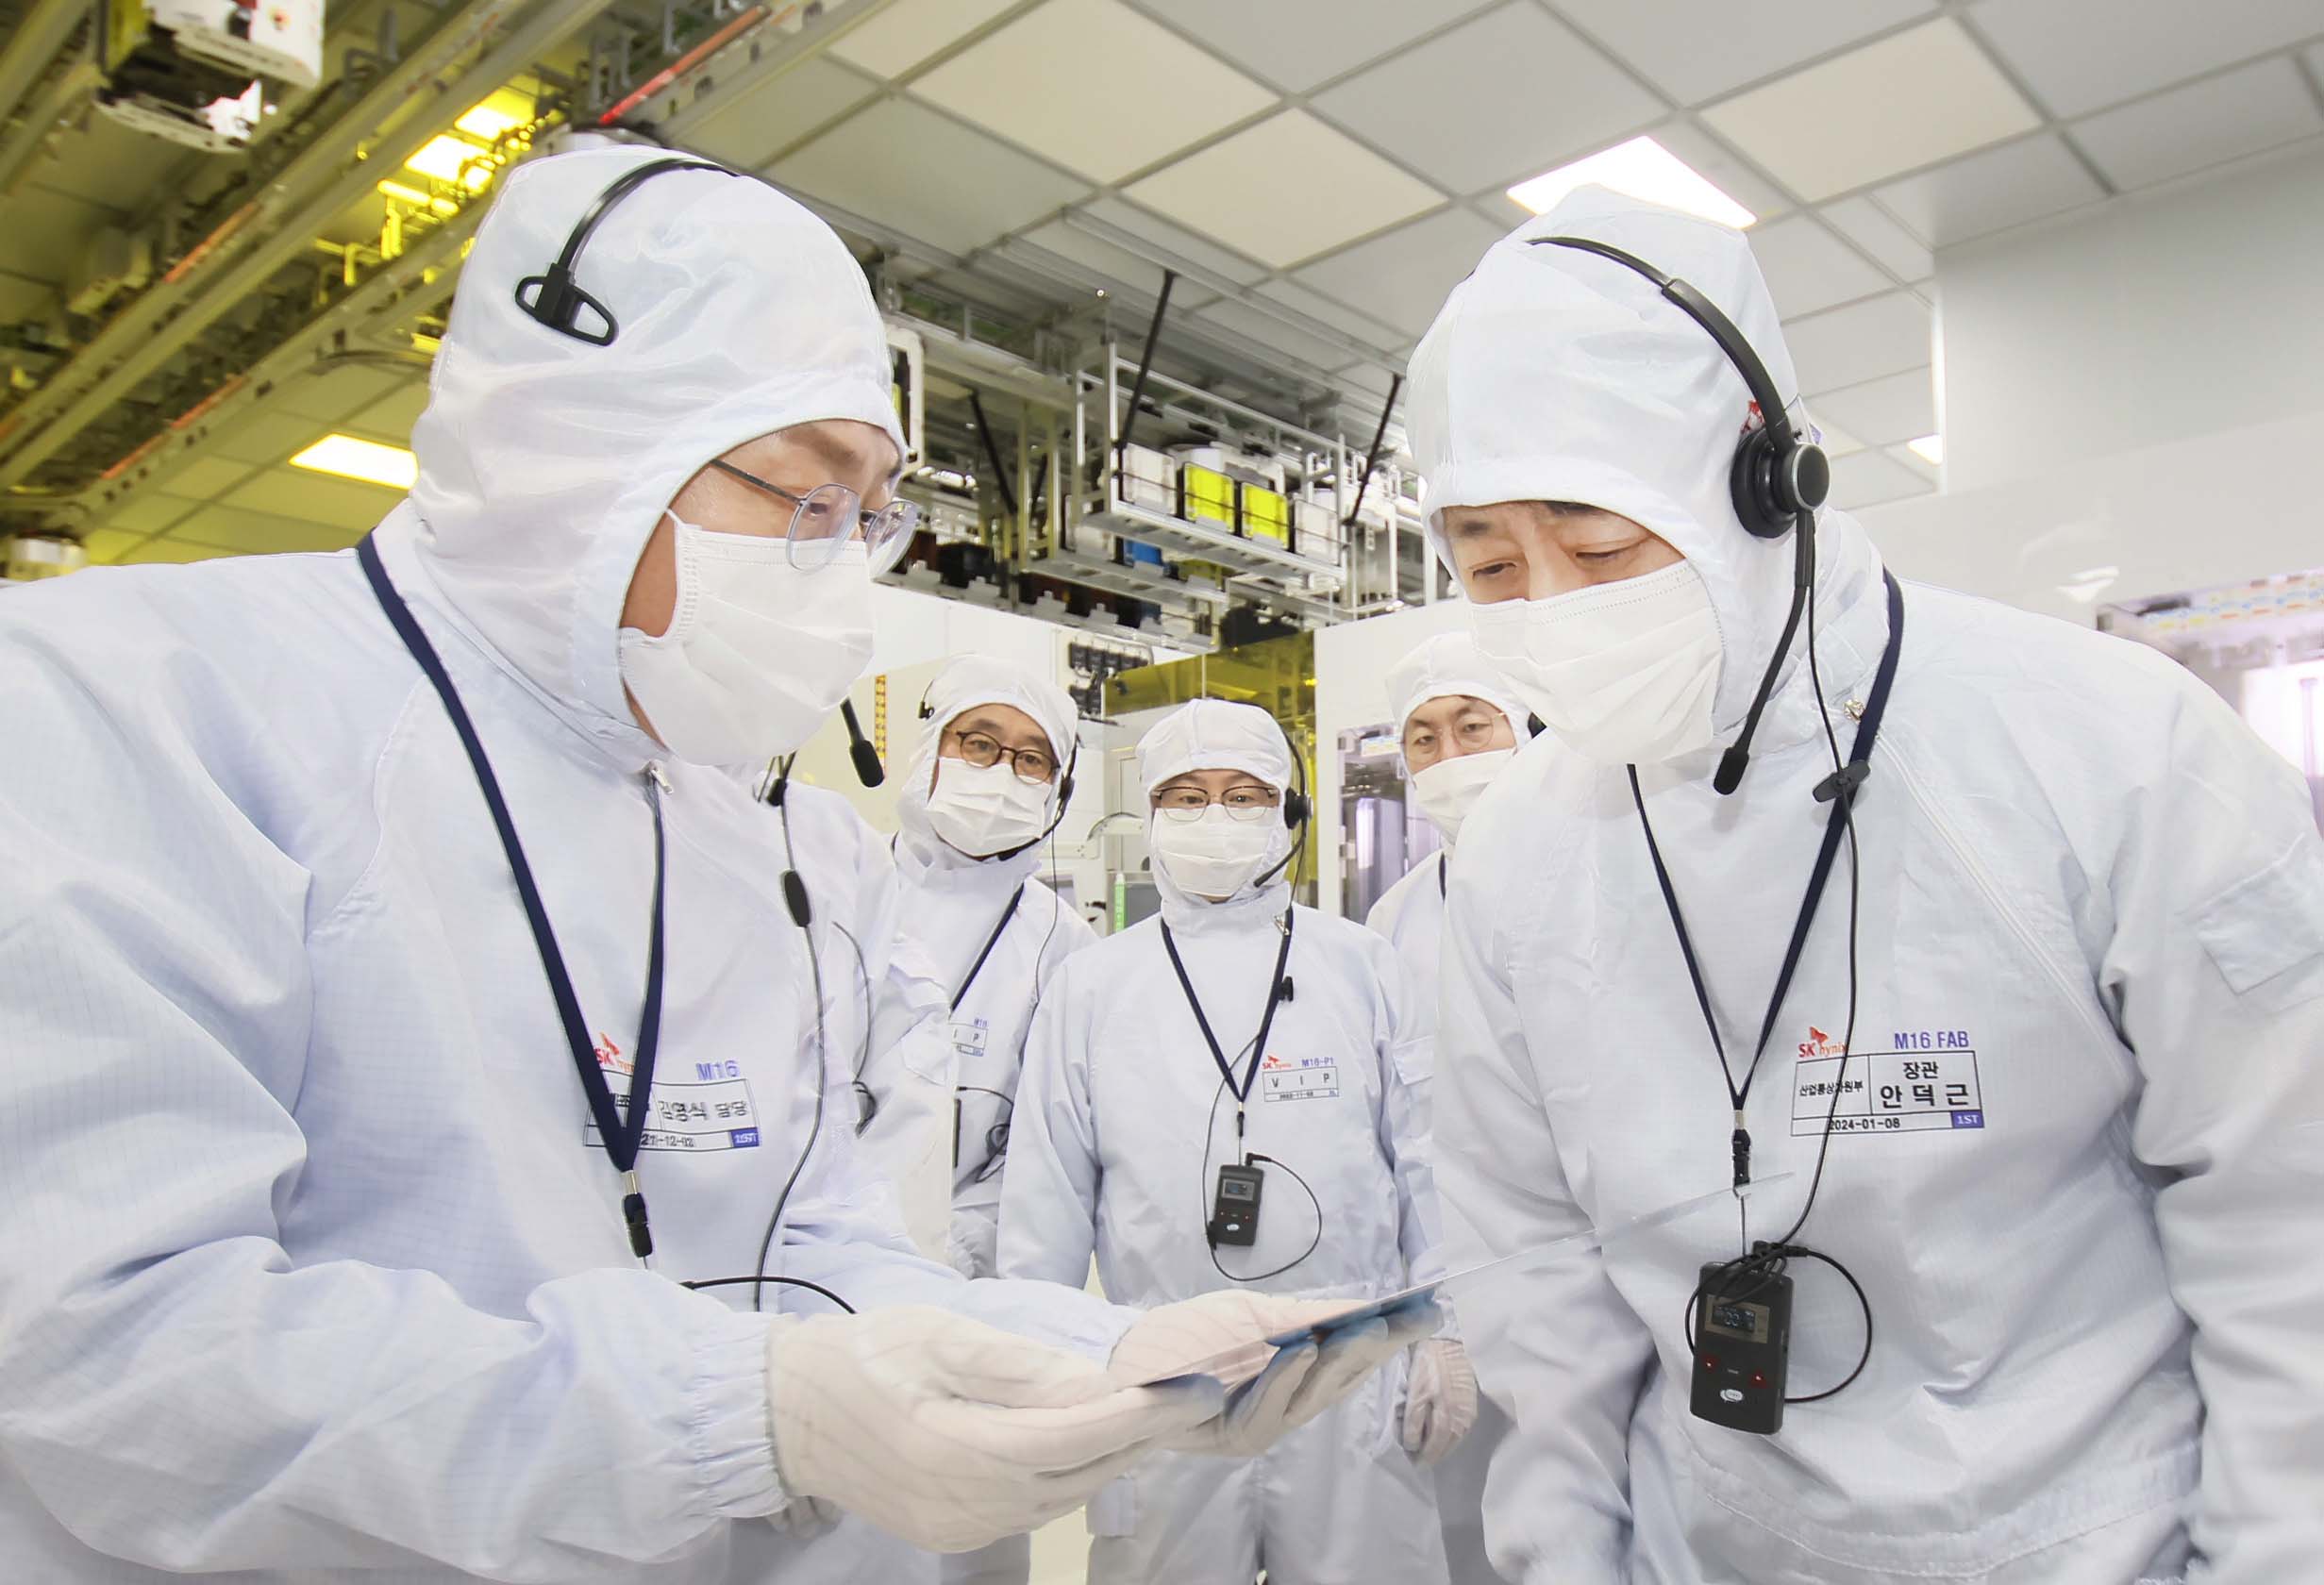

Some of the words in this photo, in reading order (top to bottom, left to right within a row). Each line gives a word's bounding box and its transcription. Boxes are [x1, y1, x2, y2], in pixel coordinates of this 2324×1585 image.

[1894, 1032, 1931, 1049] M16
[1937, 1030, 1969, 1048] FAB
[1798, 1043, 1815, 1058] SK
[695, 1059, 740, 1081] M16
[1902, 1061, 1939, 1080] 장관
[1830, 1117, 1901, 1130] 2024-01-08
[1956, 1114, 1980, 1125] 1ST
[641, 1132, 694, 1148] 21-12-02
